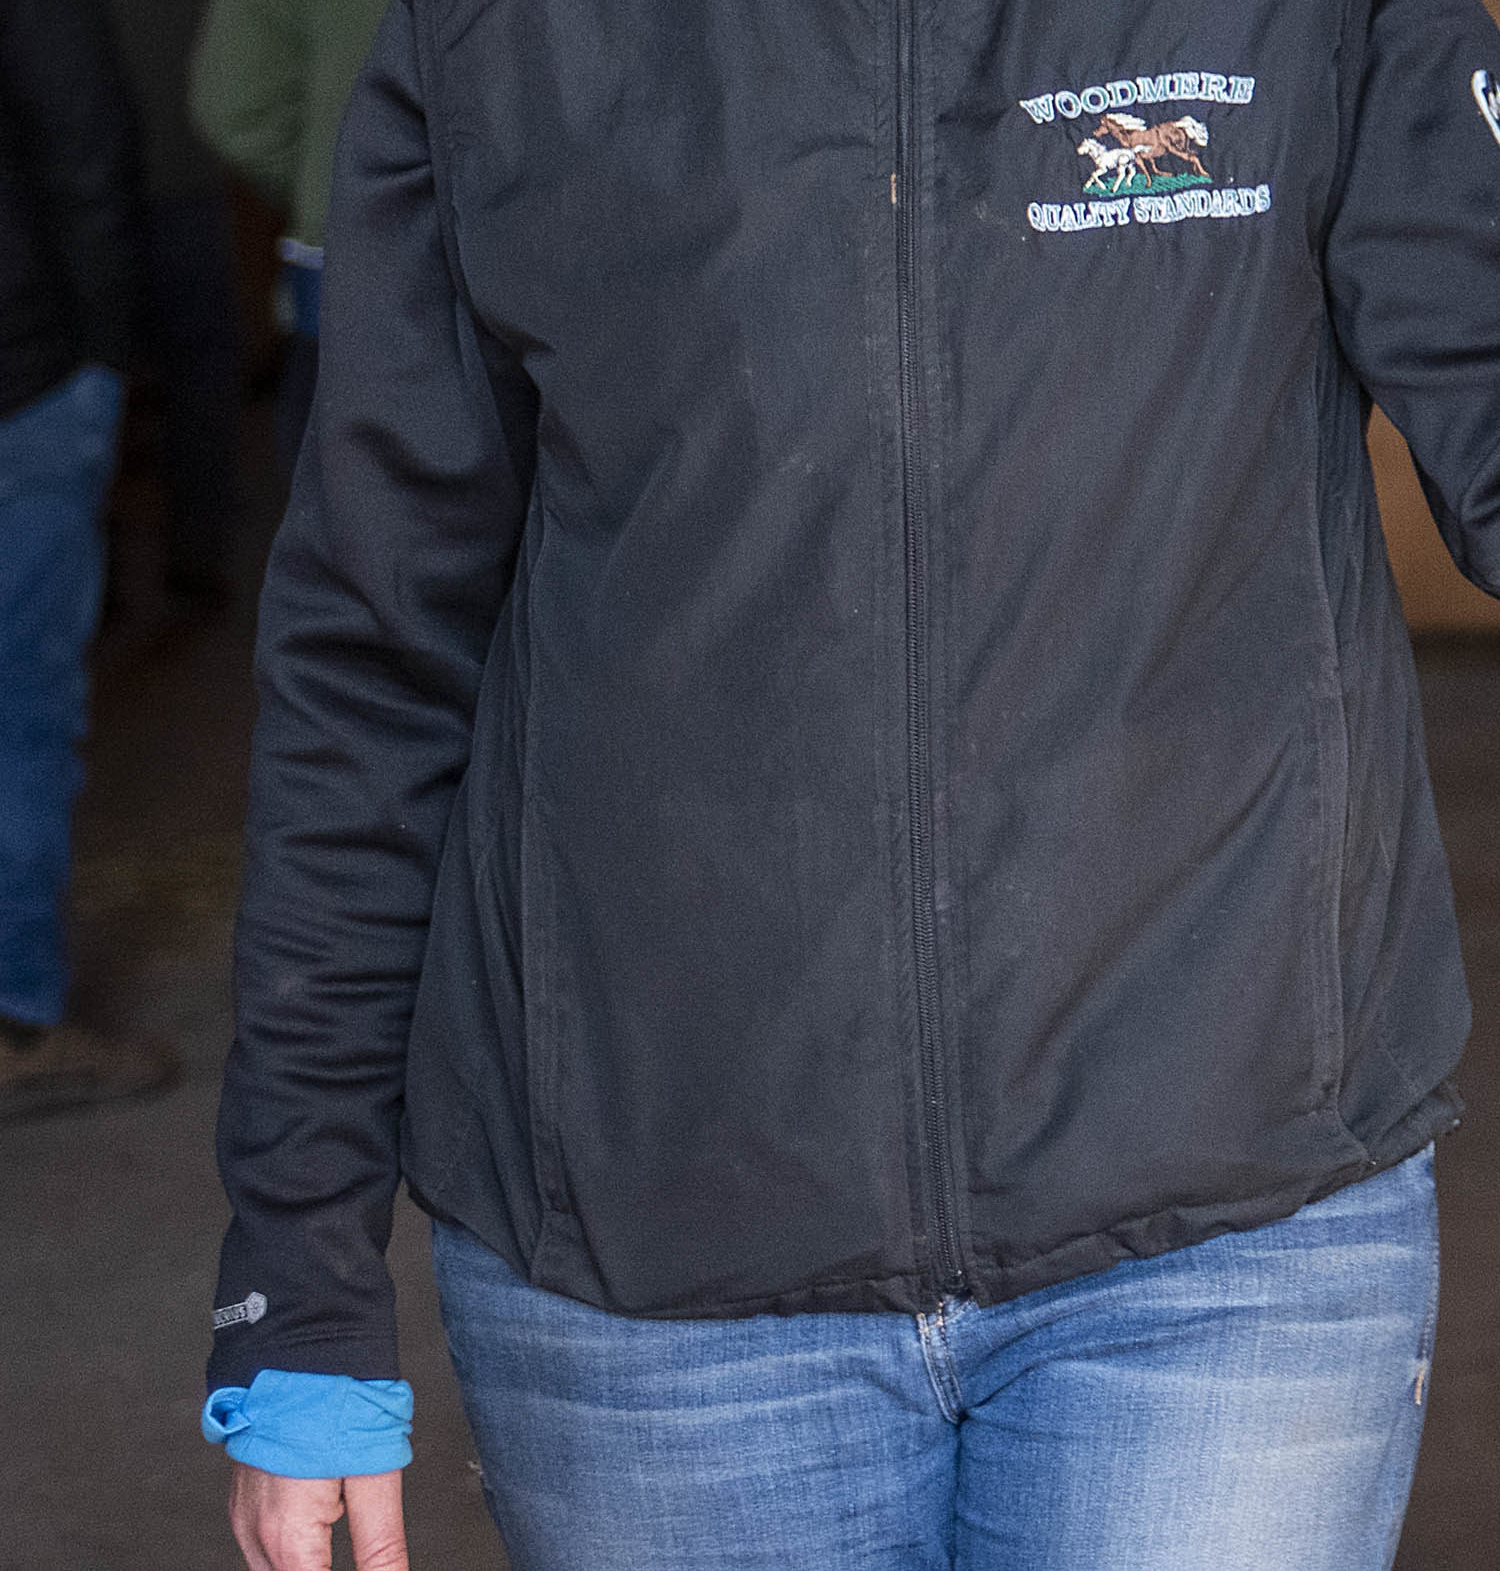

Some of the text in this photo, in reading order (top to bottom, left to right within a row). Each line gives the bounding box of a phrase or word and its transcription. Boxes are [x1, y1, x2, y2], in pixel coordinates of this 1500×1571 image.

[1019, 72, 1256, 125] WOODMERE
[1027, 184, 1271, 233] QUALITY STANDARDS
